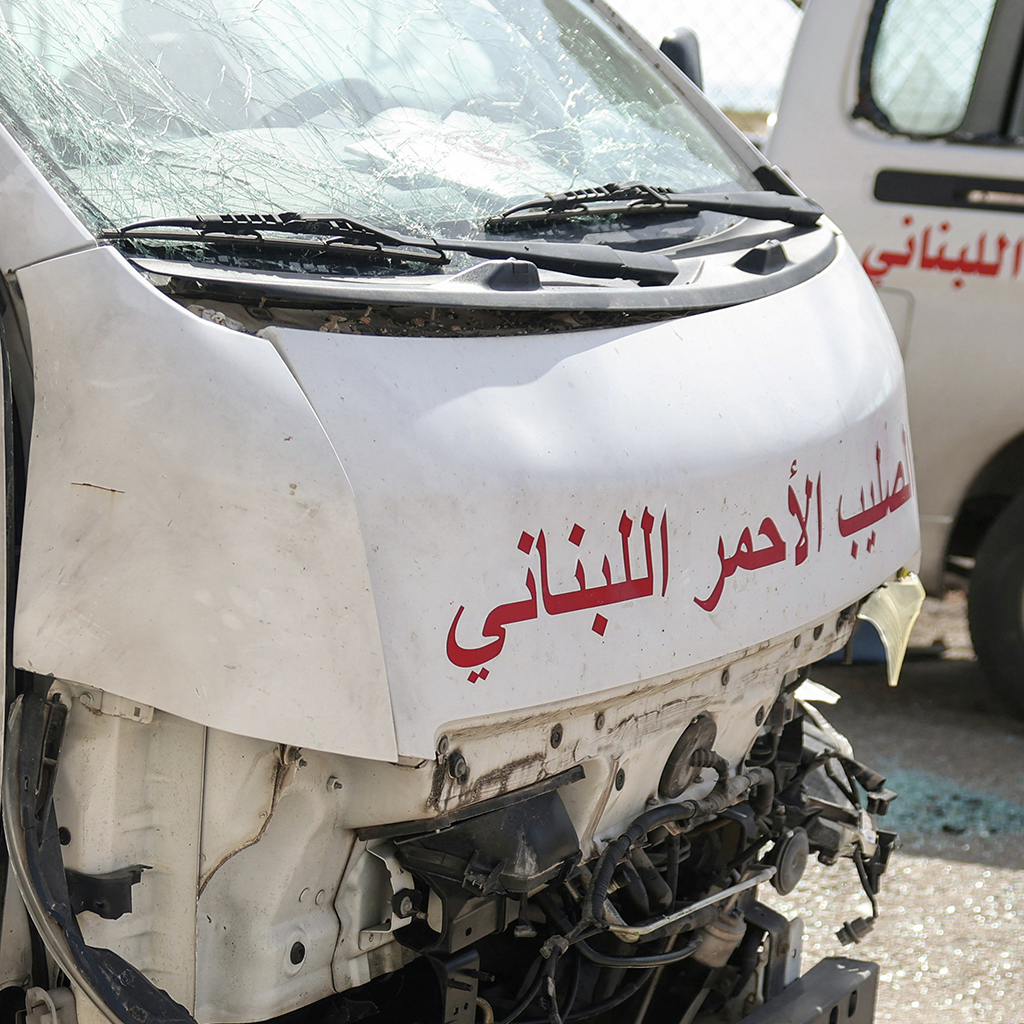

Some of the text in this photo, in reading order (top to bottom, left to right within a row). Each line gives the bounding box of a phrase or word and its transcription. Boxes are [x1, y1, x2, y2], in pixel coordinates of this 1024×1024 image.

[446, 424, 914, 684] لصليب الأحمر اللبناني
